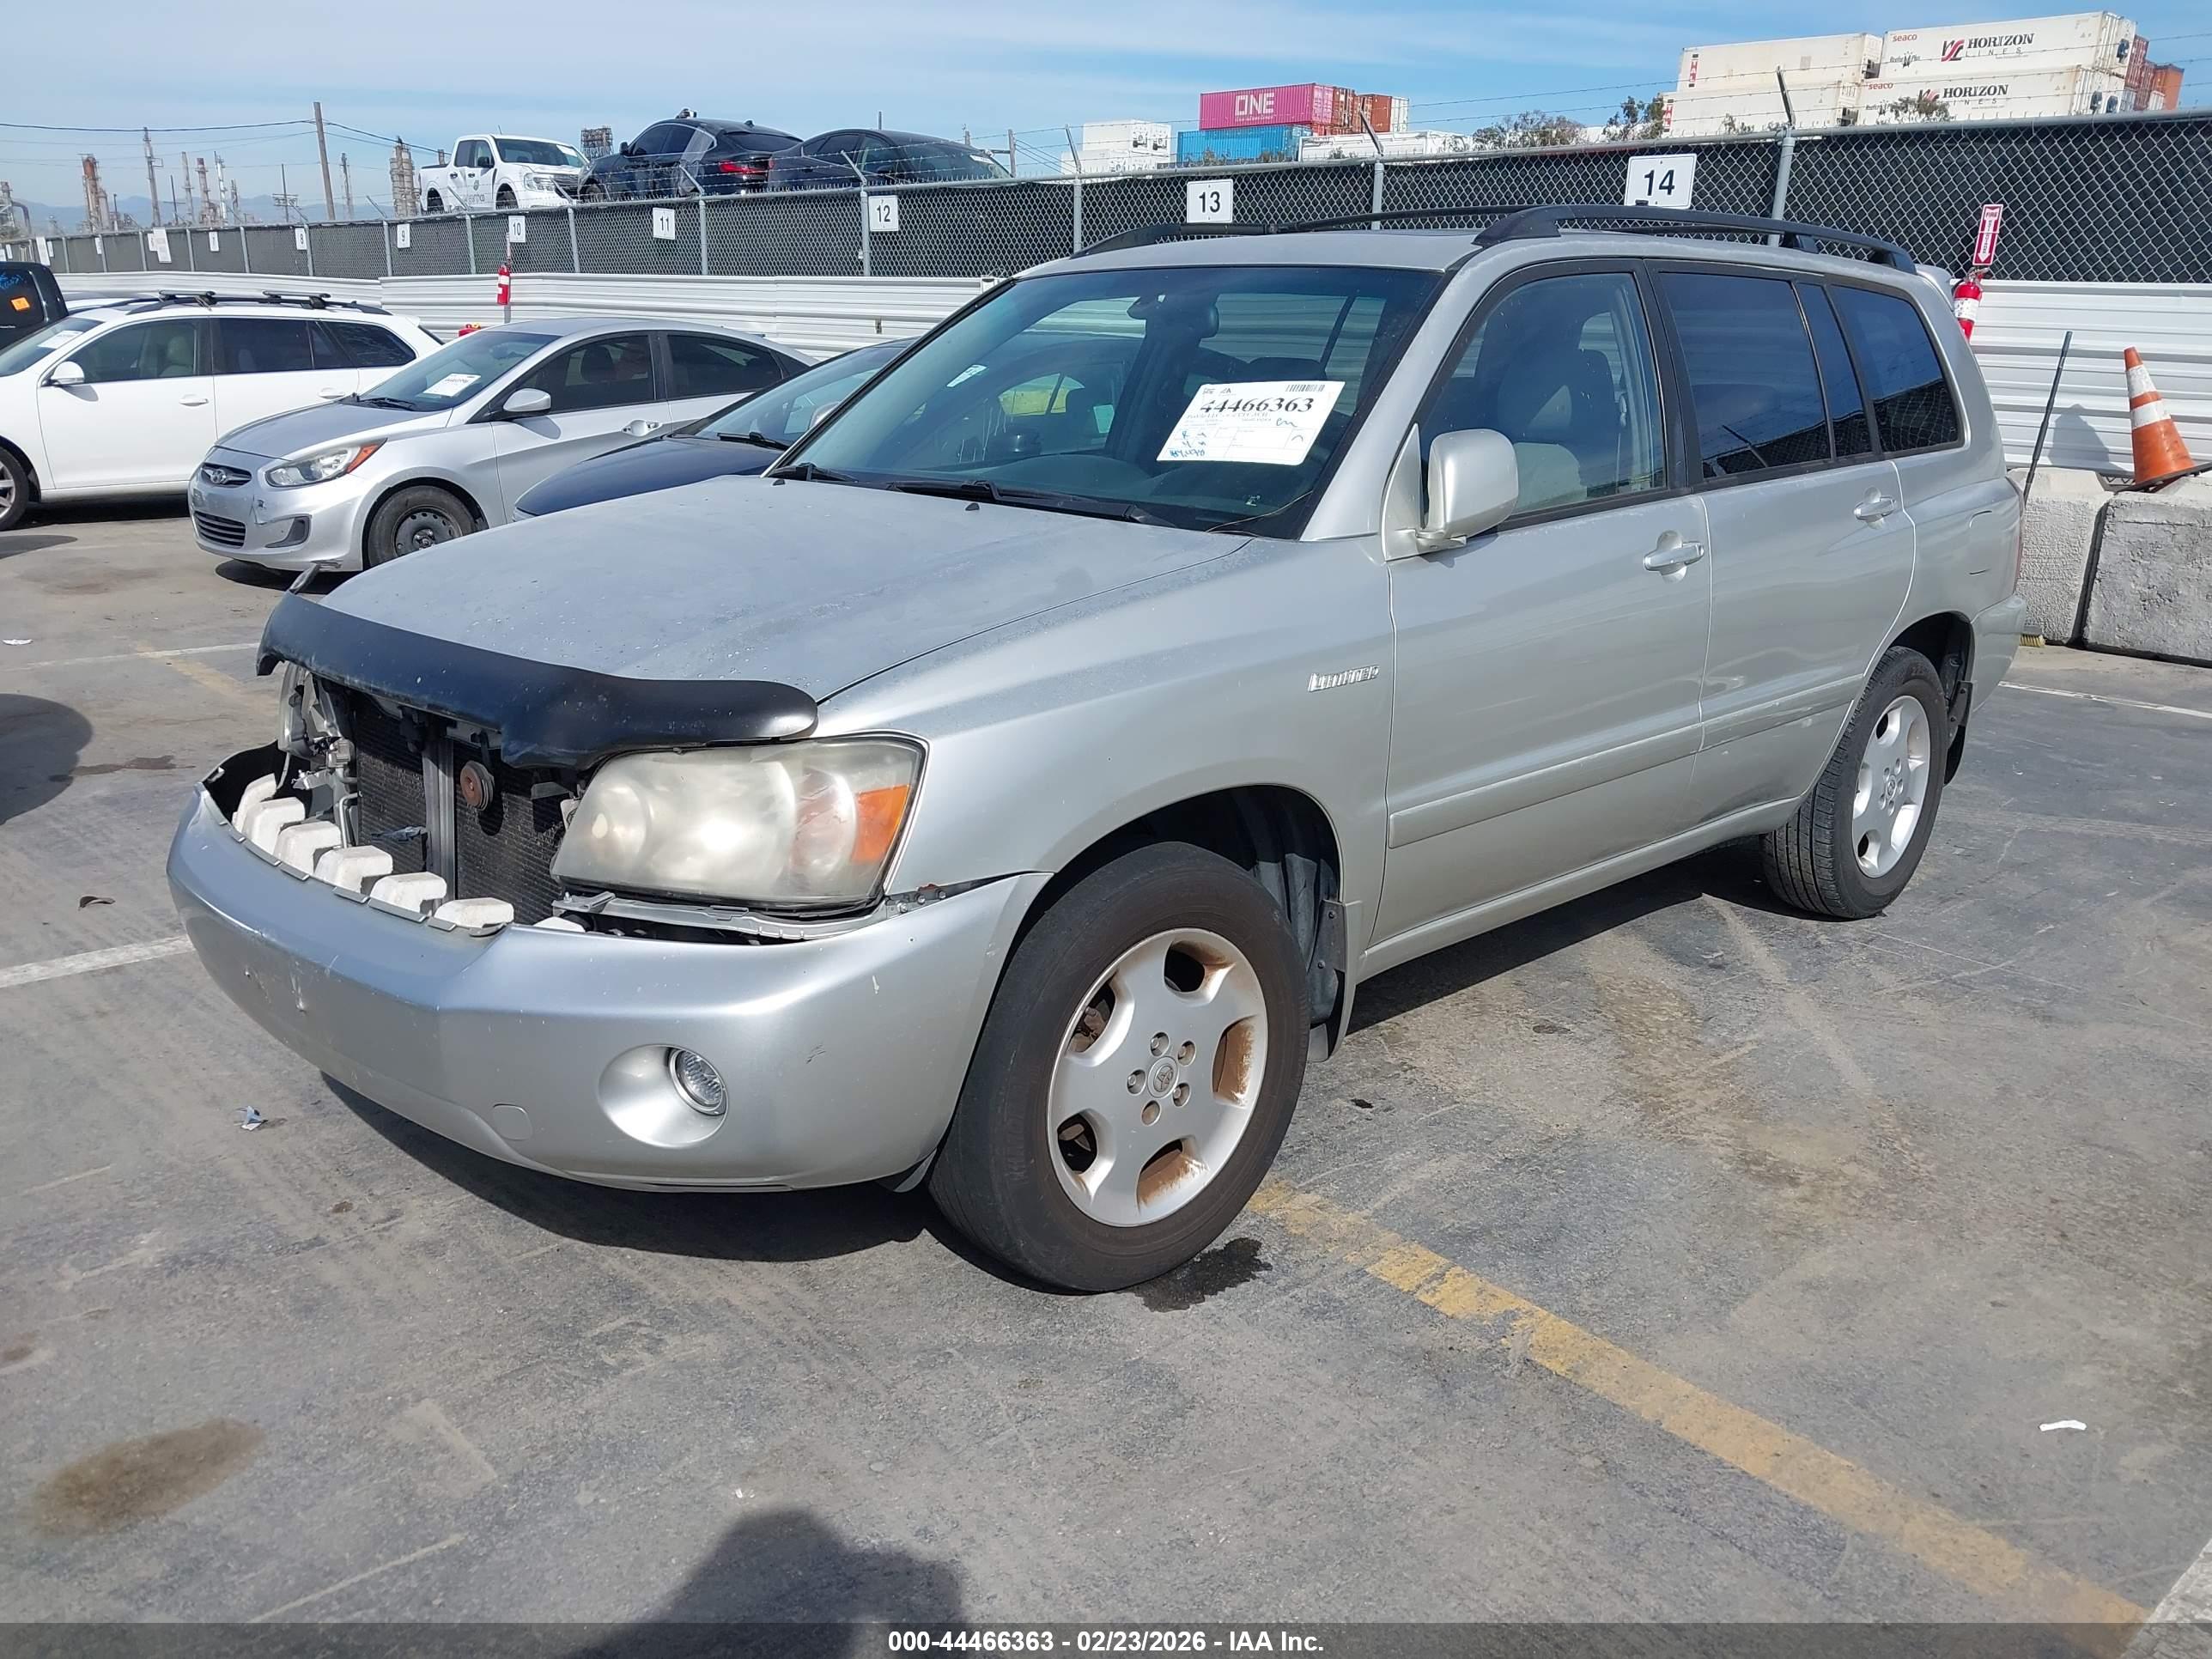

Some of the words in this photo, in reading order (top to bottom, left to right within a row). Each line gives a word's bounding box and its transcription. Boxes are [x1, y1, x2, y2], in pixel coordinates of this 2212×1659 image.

[1893, 33, 1917, 42] seaco
[1967, 33, 2035, 48] HORIZON
[1966, 46, 2023, 58] LINES
[1942, 84, 2008, 99] HORIZON
[1235, 92, 1275, 116] ONE
[1644, 169, 1675, 197] 14
[1198, 191, 1221, 214] 13
[876, 204, 891, 223] 12
[513, 222, 521, 236] 10
[659, 216, 670, 232] 11
[401, 229, 405, 242] 9
[1200, 398, 1315, 413] 44466363
